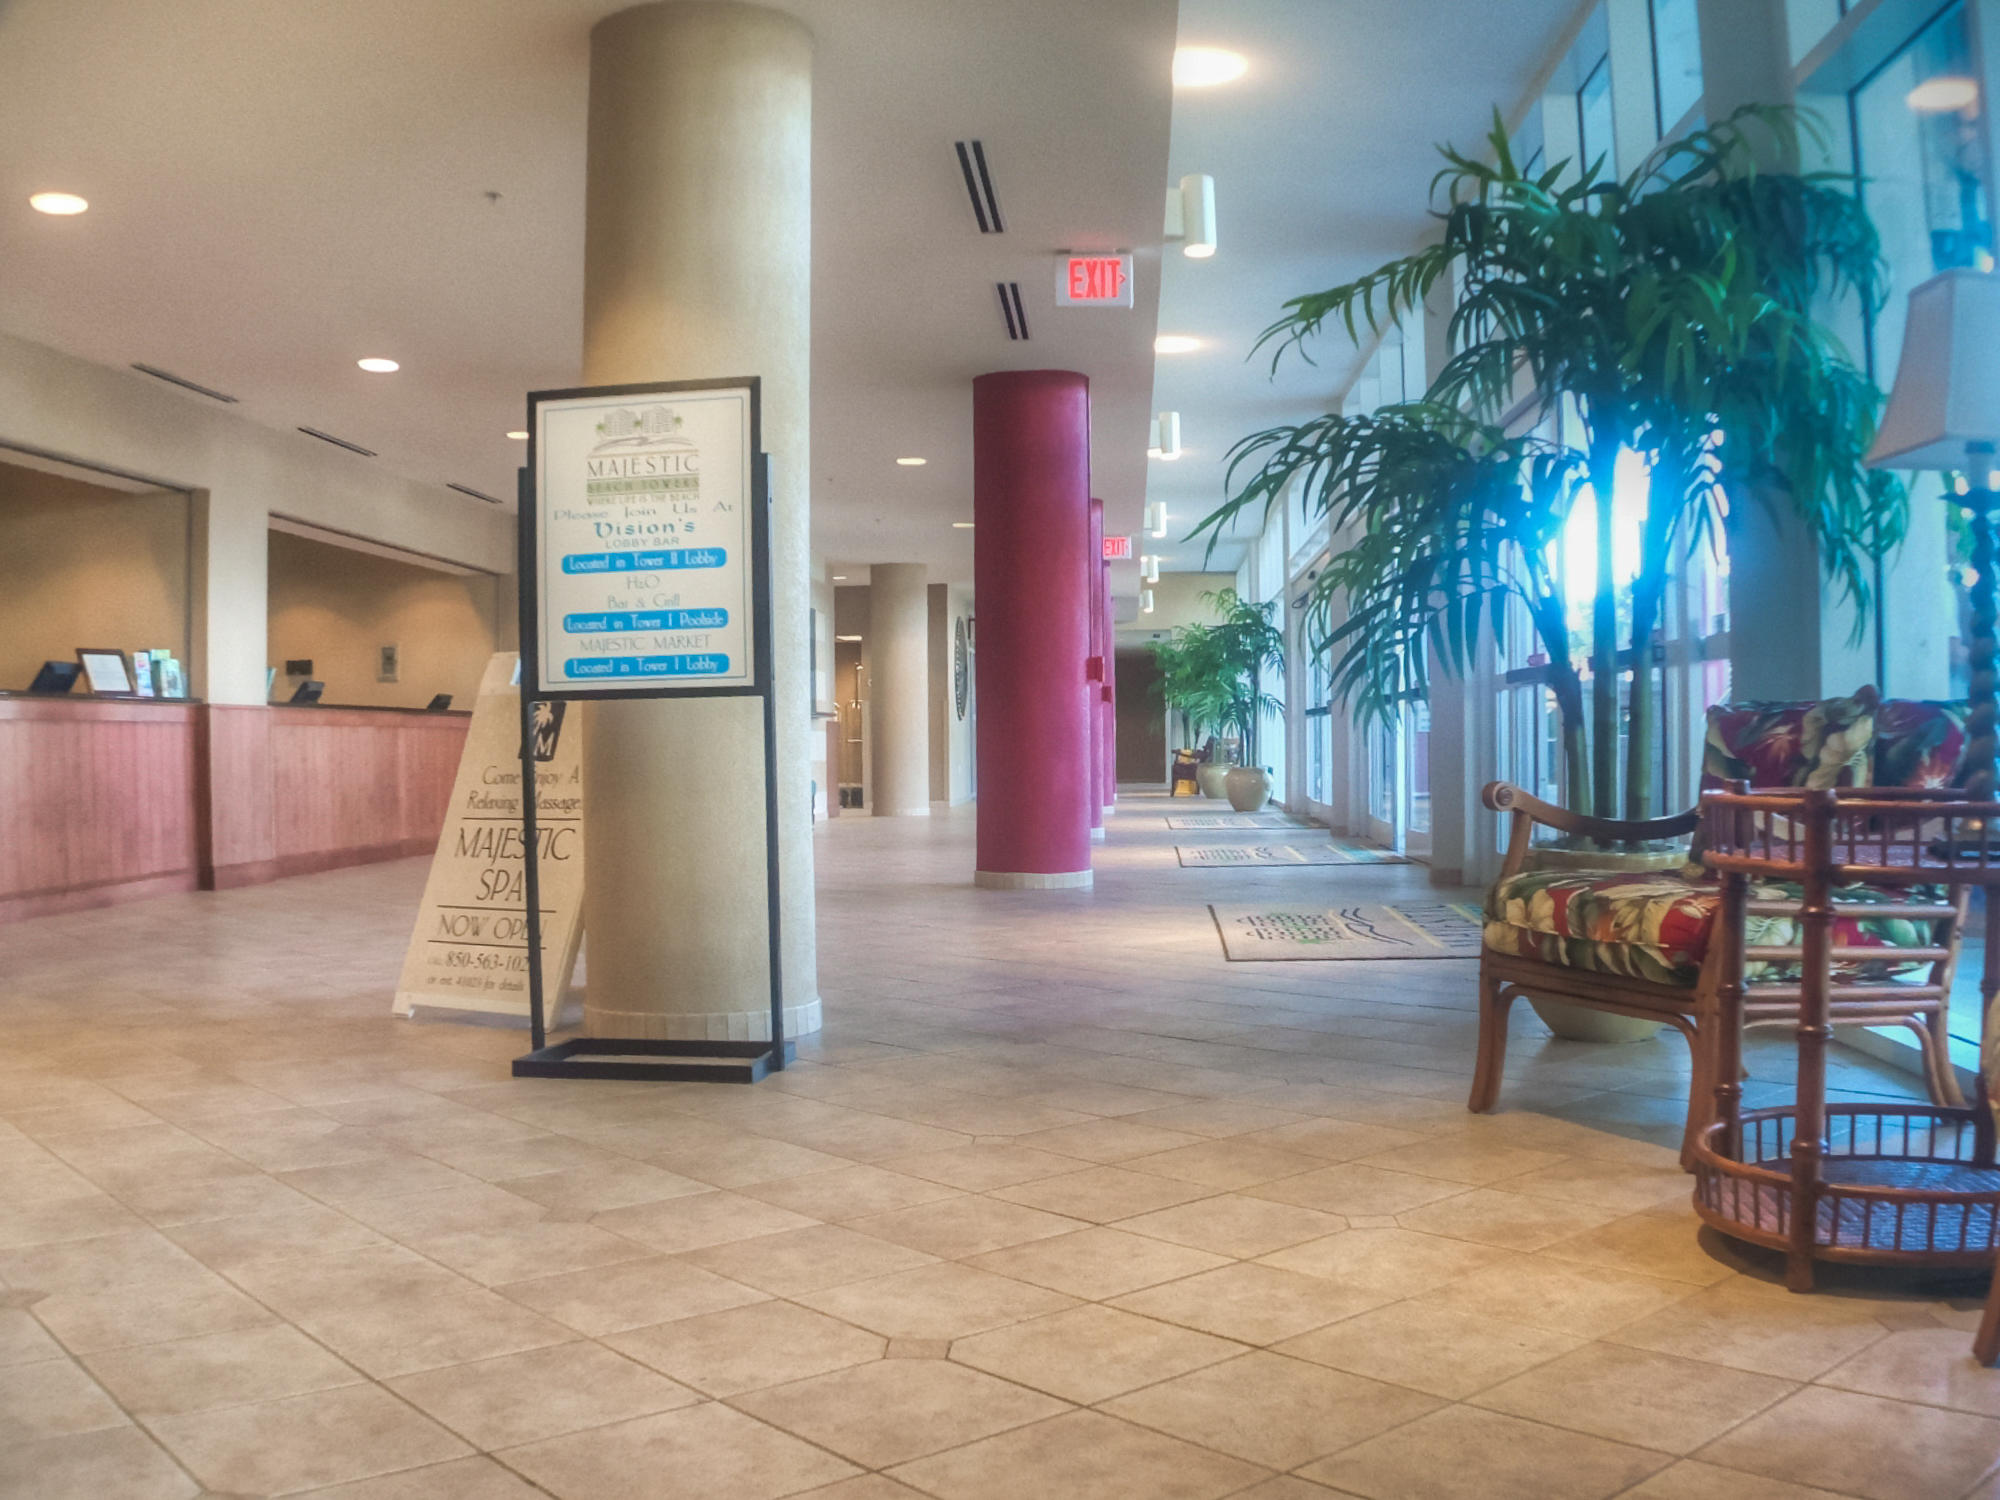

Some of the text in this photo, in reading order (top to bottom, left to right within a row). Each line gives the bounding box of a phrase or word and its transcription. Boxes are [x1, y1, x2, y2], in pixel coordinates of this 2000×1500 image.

[1068, 258, 1121, 299] EXIT
[587, 454, 699, 478] MAJESTIC
[554, 501, 734, 520] Please Join Us At
[594, 519, 696, 538] Vision's
[605, 536, 680, 549] LOBBY BAR
[1104, 538, 1126, 556] EXIT
[569, 555, 609, 570] Located
[633, 552, 664, 567] Tower
[685, 550, 718, 565] Lobby
[607, 593, 680, 609] Bar & Grill
[566, 616, 607, 631] Located
[630, 614, 661, 628] Tower
[679, 611, 724, 626] Poolside
[579, 634, 712, 653] MAJESTIC MARKET
[573, 660, 614, 674] Located
[636, 658, 667, 672] Tower
[686, 655, 718, 672] Lobby
[483, 765, 521, 785] Come
[568, 765, 579, 784] A
[535, 791, 581, 814] assage
[475, 868, 523, 902] SPA
[437, 914, 490, 937] NOW
